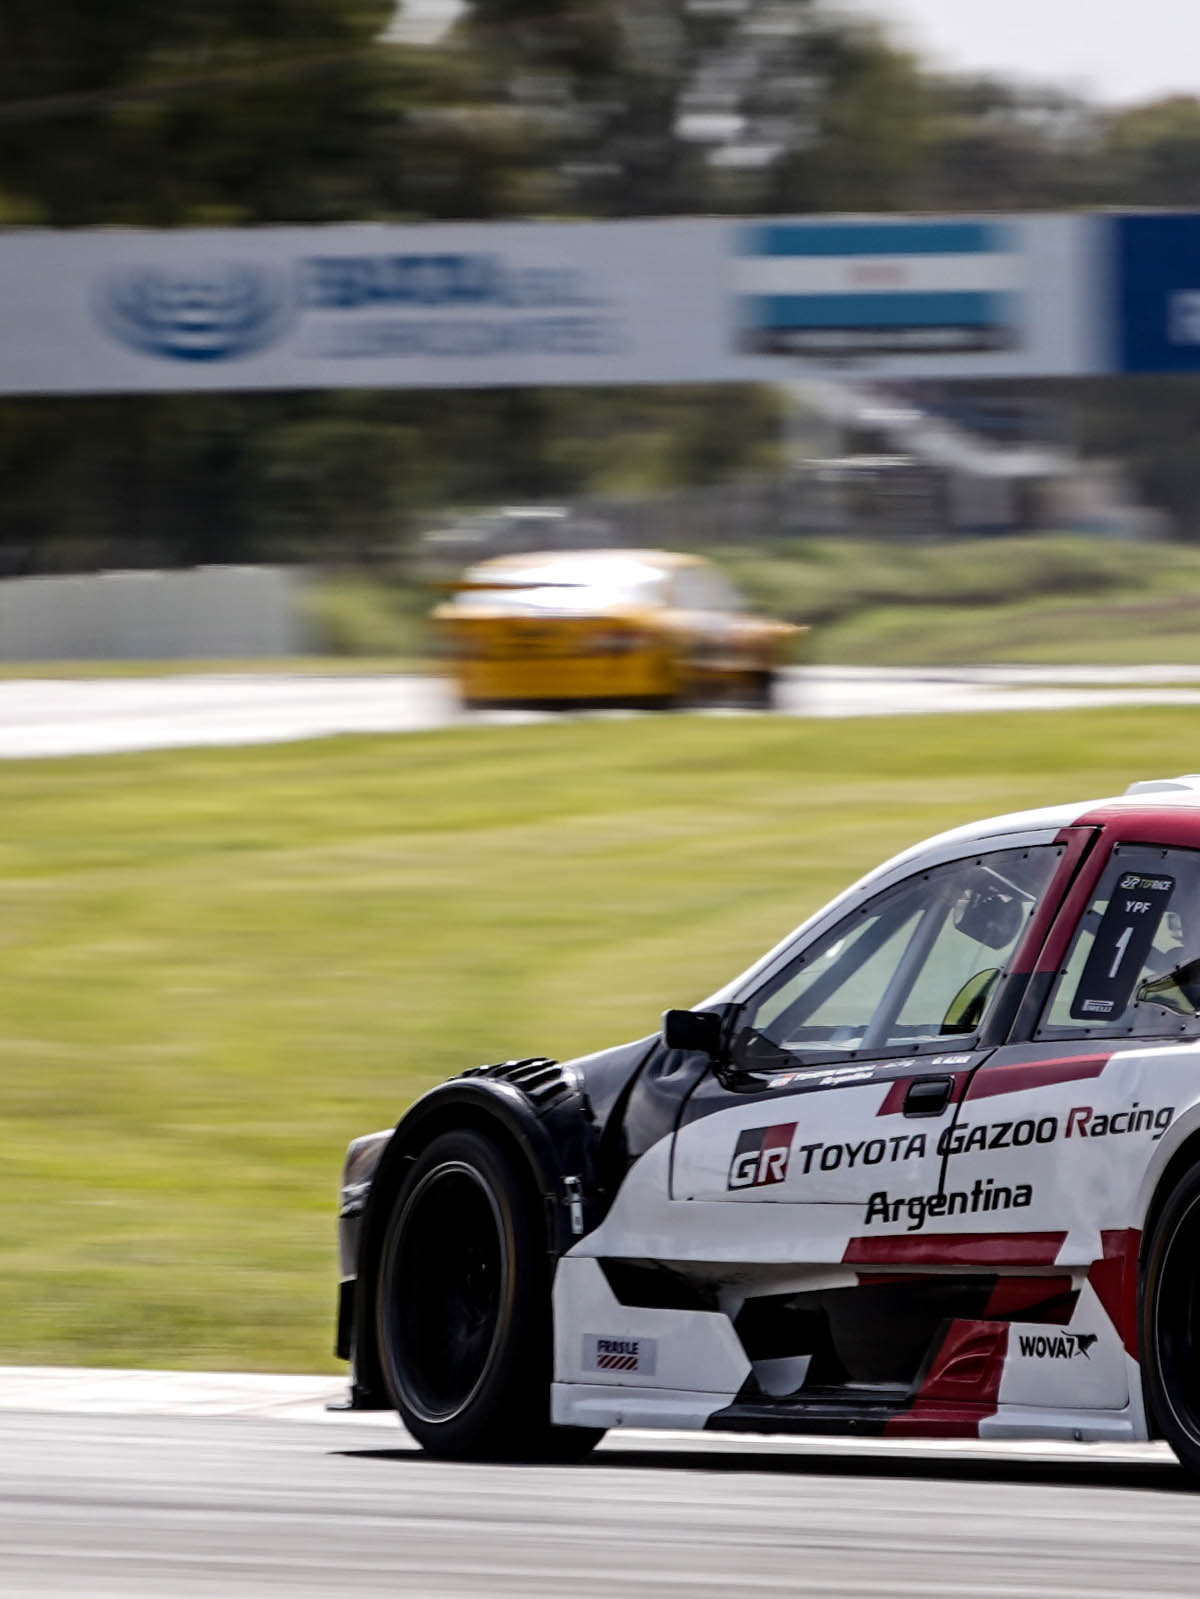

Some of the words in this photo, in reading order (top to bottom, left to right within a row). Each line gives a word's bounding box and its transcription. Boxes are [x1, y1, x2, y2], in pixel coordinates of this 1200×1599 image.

[1125, 900, 1152, 914] YPF
[1108, 926, 1134, 979] 1
[729, 1146, 788, 1188] GR
[800, 1133, 927, 1174] TOYOTA
[936, 1116, 1058, 1157] GAZOO
[1064, 1102, 1176, 1140] Racing
[864, 1178, 1033, 1231] Argentina
